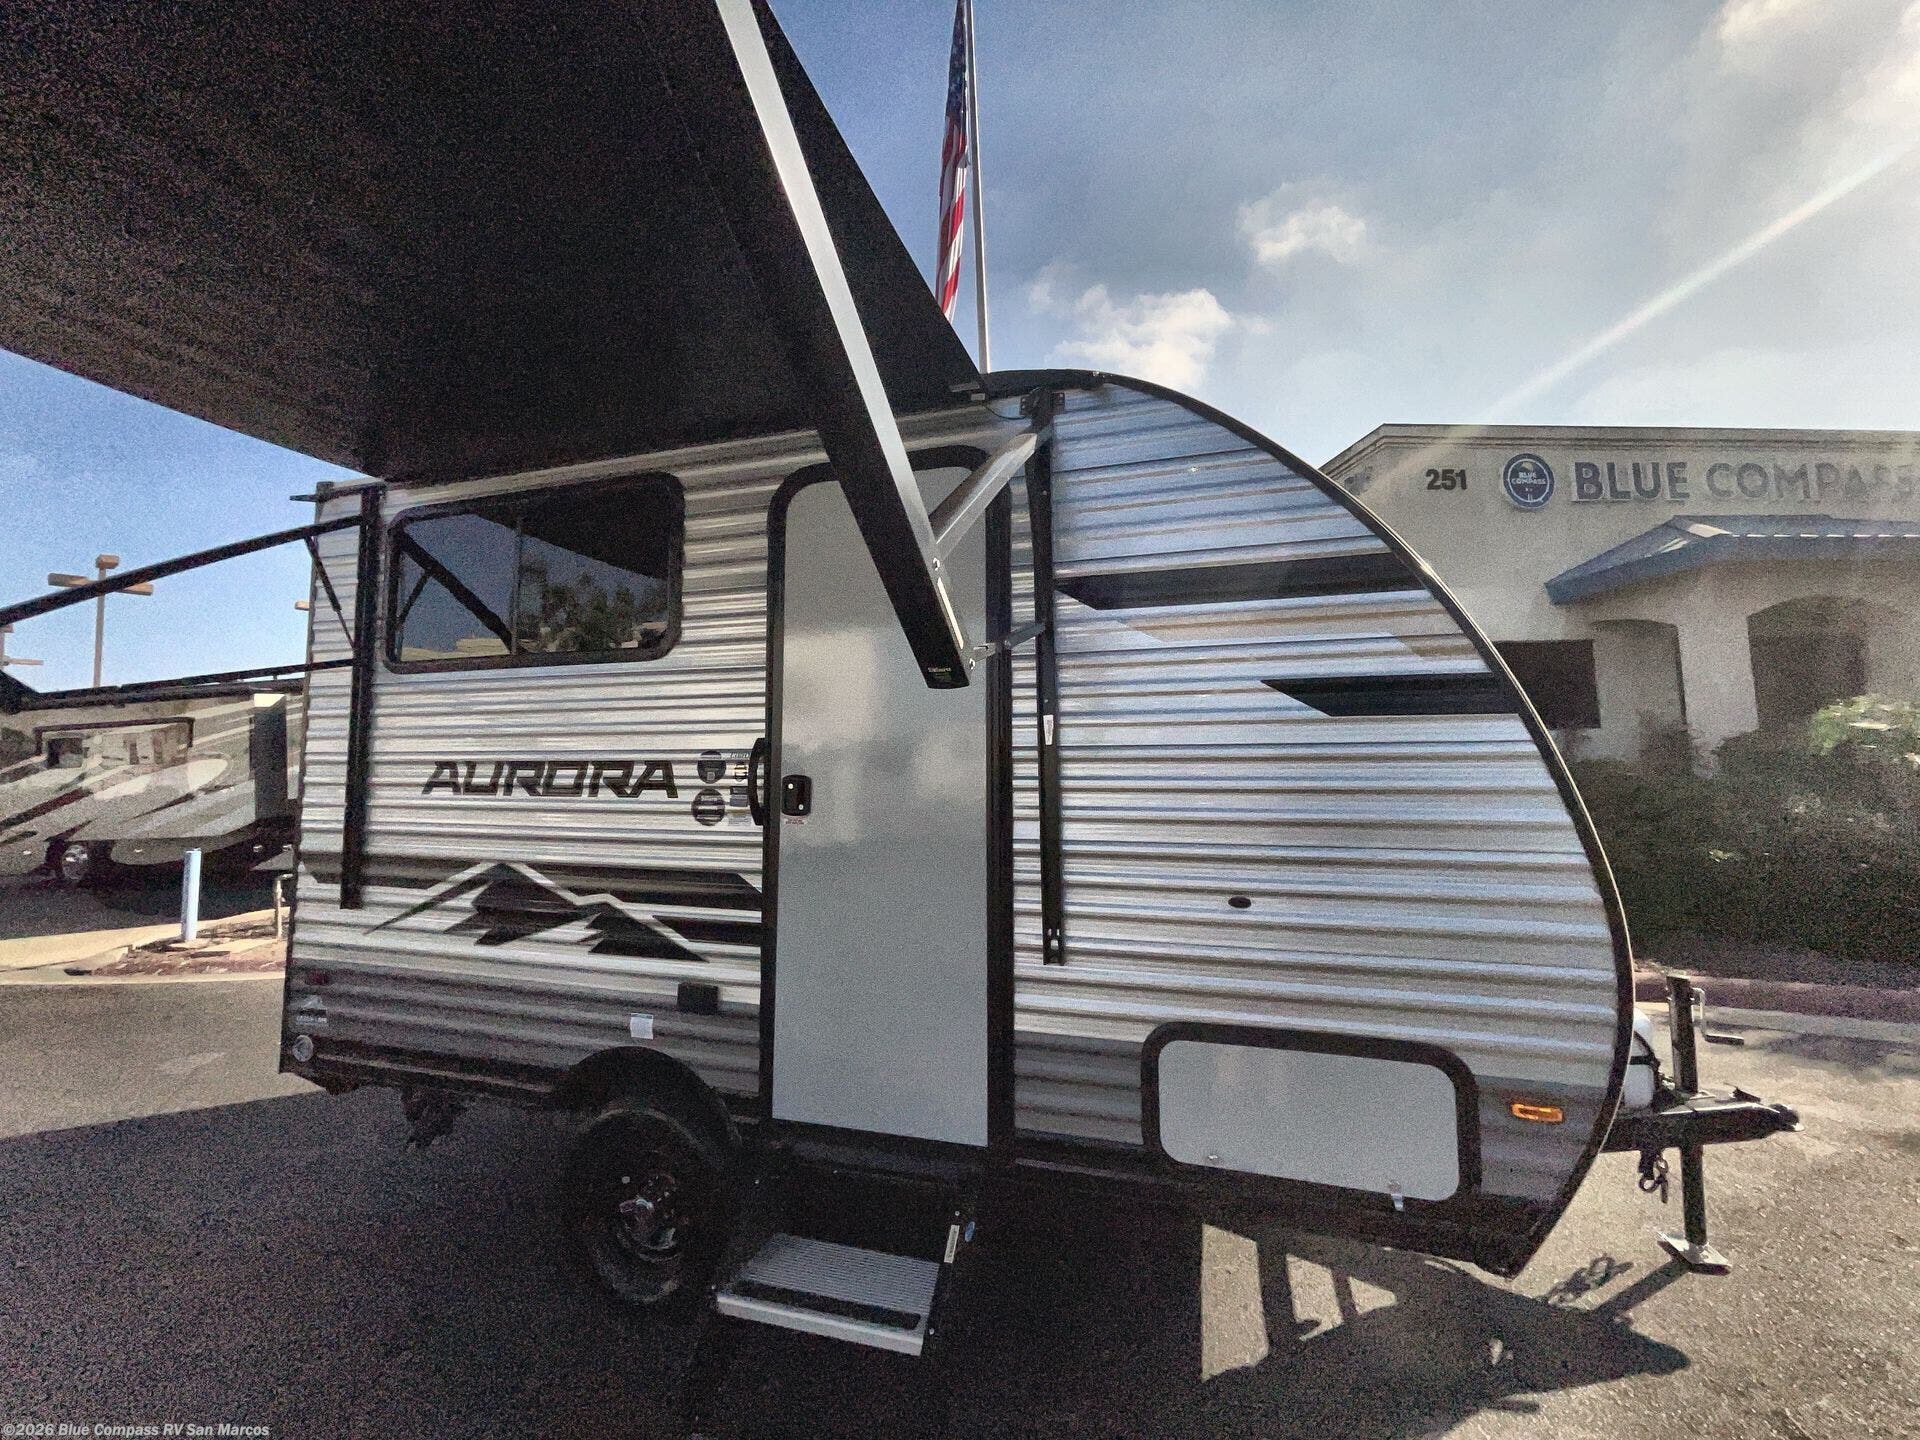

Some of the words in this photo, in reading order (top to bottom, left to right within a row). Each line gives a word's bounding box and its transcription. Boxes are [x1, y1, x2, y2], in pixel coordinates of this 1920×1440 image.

[1425, 468, 1468, 491] 251
[1574, 461, 1690, 500] BLUE
[421, 760, 679, 799] AURORA
